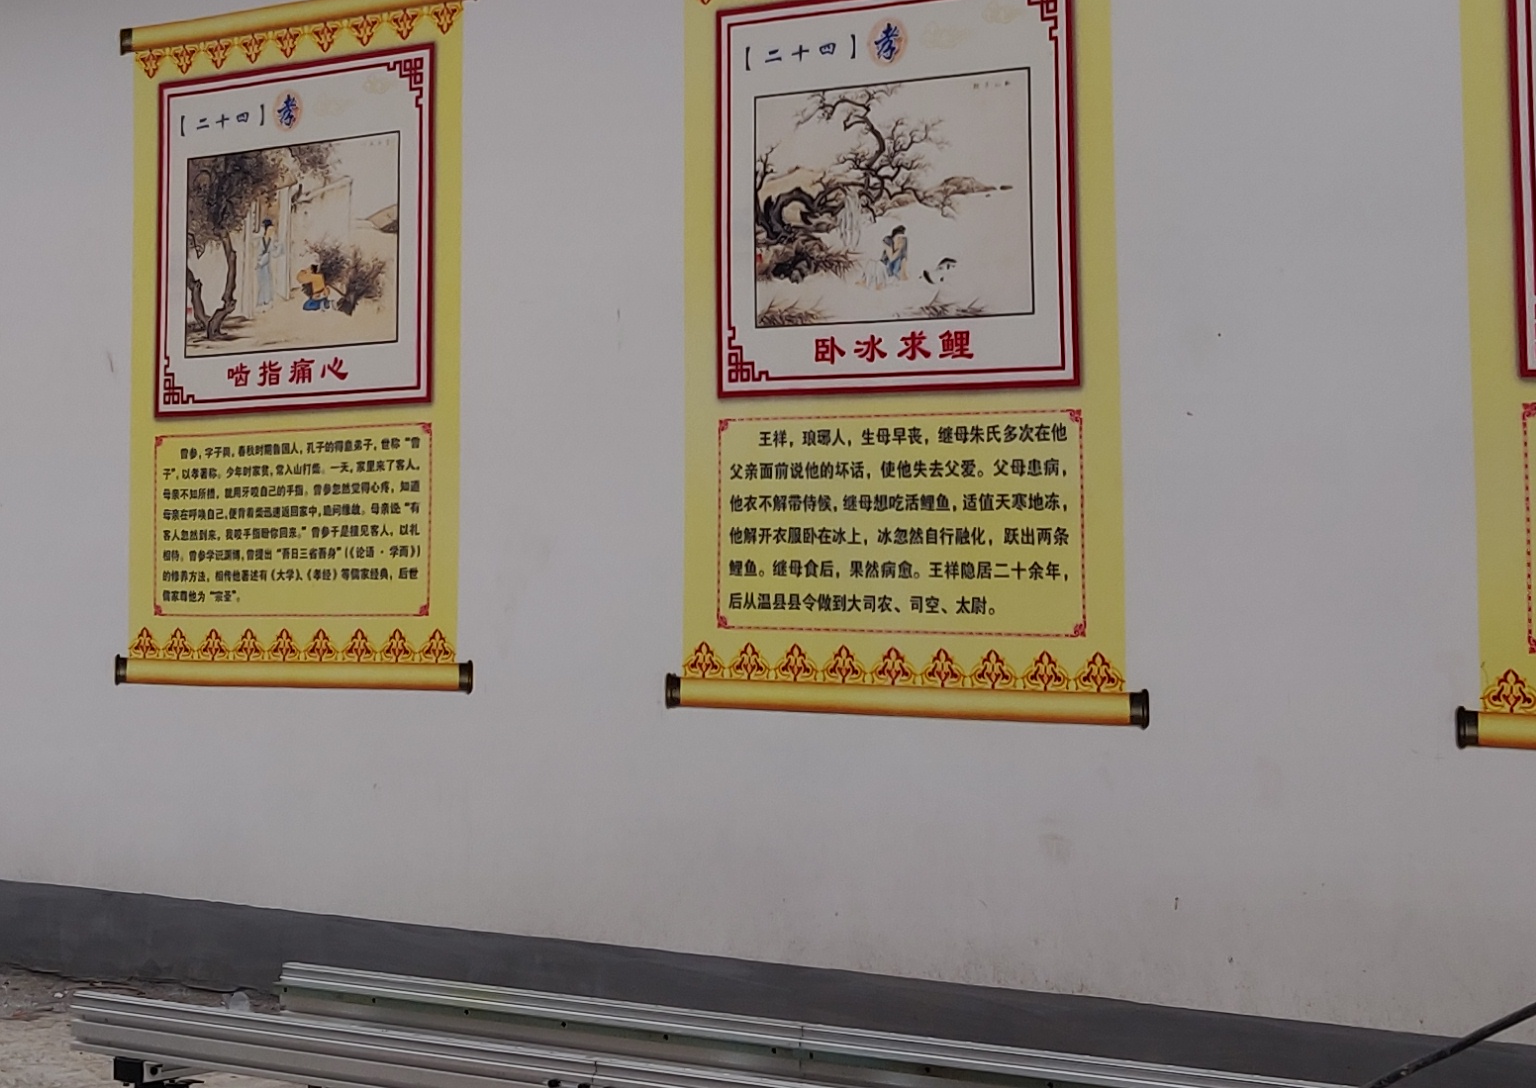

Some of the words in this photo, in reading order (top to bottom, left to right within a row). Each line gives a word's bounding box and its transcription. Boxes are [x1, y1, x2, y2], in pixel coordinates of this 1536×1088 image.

[814, 330, 974, 364] 卧冰求鲤
[227, 356, 349, 388] 啮指痛心
